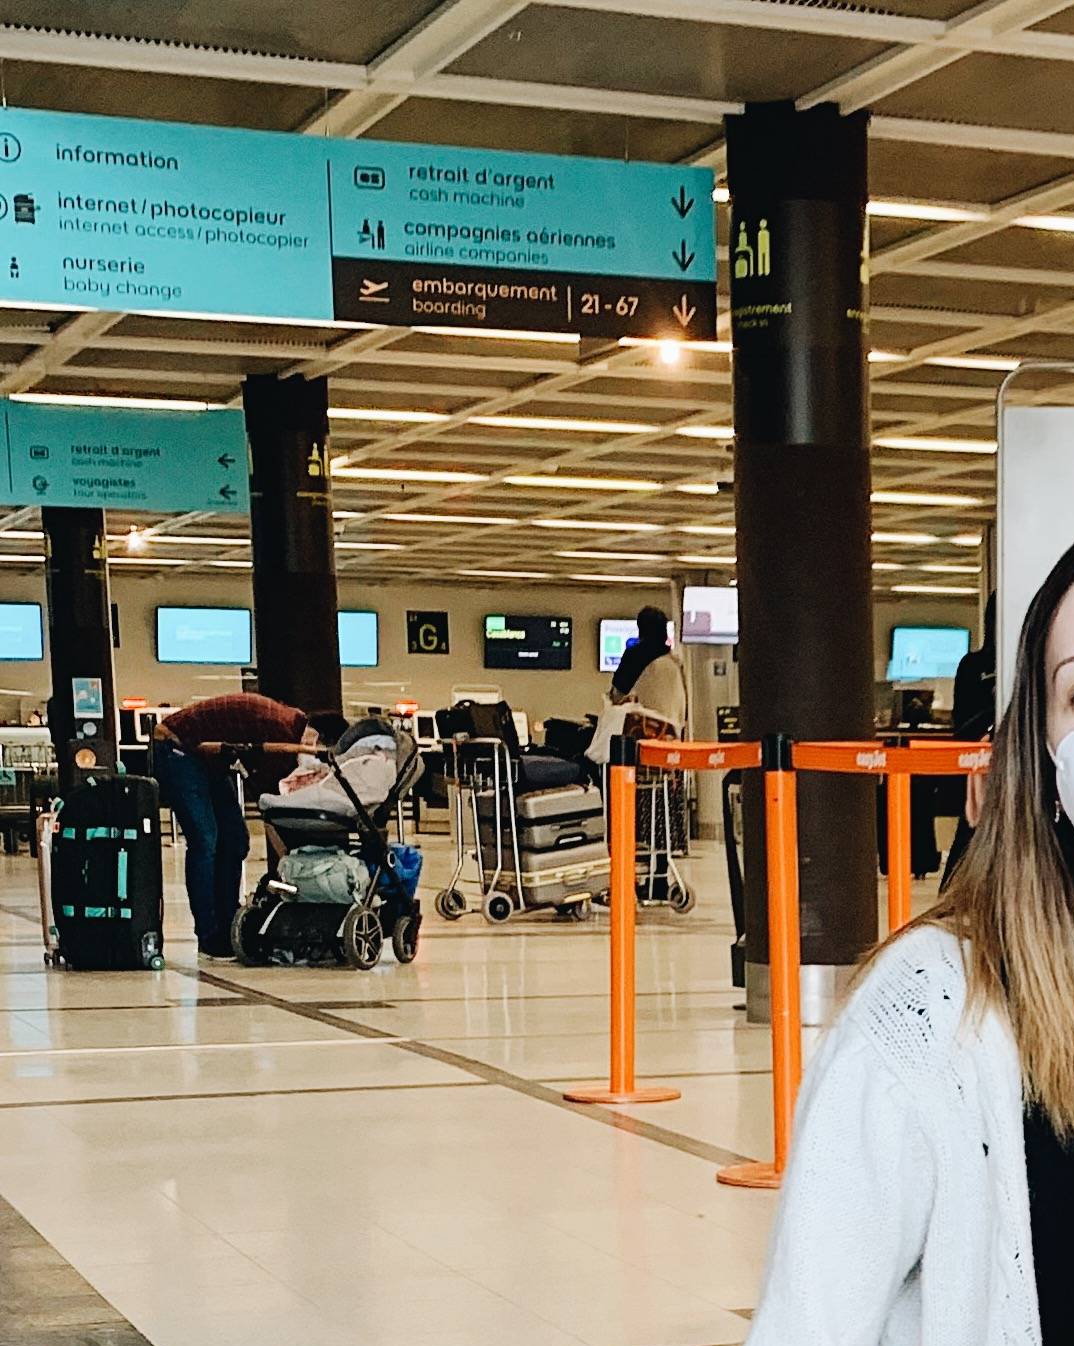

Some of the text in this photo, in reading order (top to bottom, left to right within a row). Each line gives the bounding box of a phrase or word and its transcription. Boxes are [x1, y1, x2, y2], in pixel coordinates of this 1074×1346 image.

[56, 143, 179, 171] information
[409, 165, 555, 192] retrait d'argent
[410, 187, 525, 208] cash machine
[59, 217, 129, 235] internet
[404, 221, 615, 249] compagnies aériennes
[405, 241, 548, 265] airline companies
[63, 256, 146, 275] nurserie
[64, 276, 182, 300] baby change
[412, 278, 557, 301] embarquement
[412, 297, 487, 320] boarding
[419, 623, 438, 650] G
